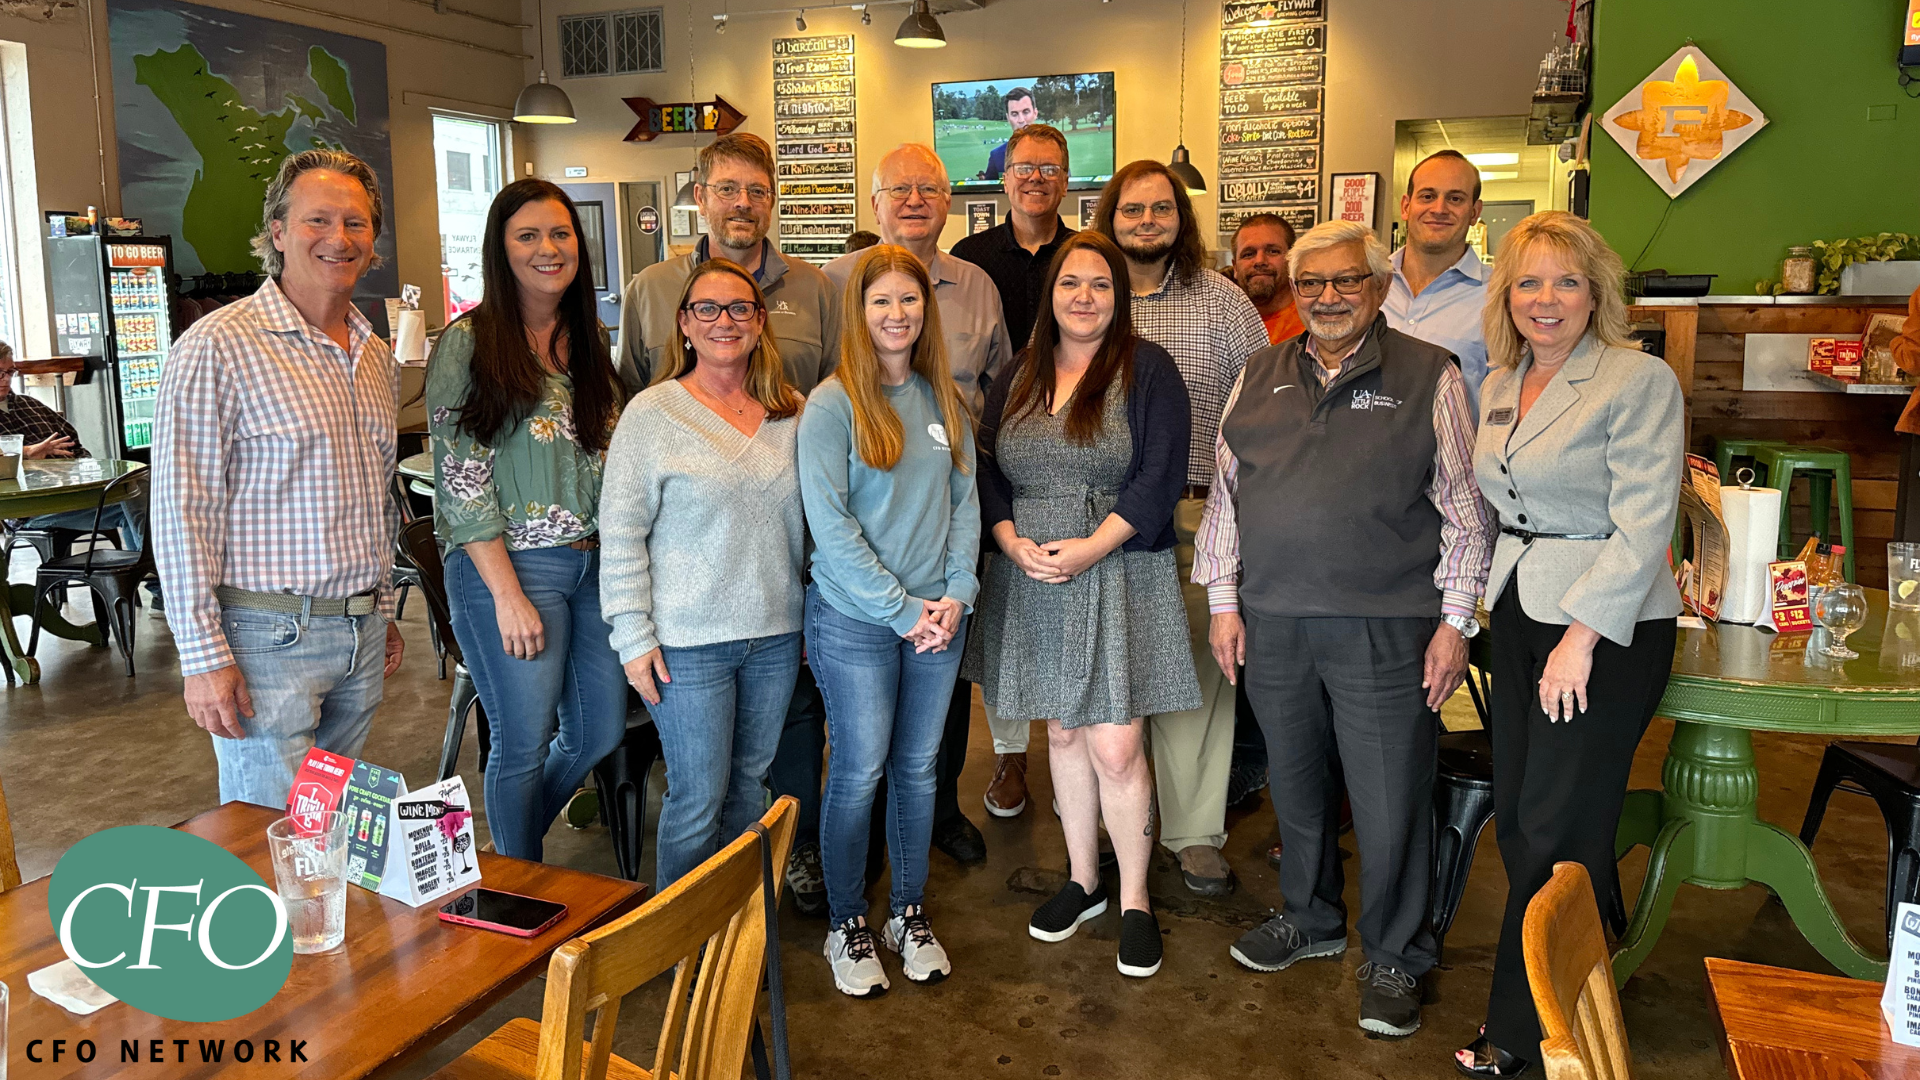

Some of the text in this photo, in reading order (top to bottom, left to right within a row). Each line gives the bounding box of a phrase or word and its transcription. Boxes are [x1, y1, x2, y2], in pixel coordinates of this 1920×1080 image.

[1225, 4, 1261, 23] Welcome
[1228, 28, 1315, 42] WHICH CAME FIRST?
[1224, 94, 1246, 104] BEER
[1270, 102, 1284, 111] days
[1291, 100, 1307, 108] week
[1224, 103, 1249, 114] TO GO
[649, 106, 698, 132] BEER
[1282, 119, 1311, 130] options
[1657, 105, 1708, 137] F
[1222, 132, 1240, 144] Coke
[1241, 131, 1260, 142] Sprite
[786, 144, 804, 154] Lord
[807, 144, 823, 154] God
[1222, 155, 1240, 163] WINE
[1240, 154, 1259, 162] MENU
[790, 184, 811, 195] Golden
[1344, 178, 1366, 188] GOOD
[1224, 182, 1270, 201] LOBLOLLY
[1297, 181, 1315, 198] $4
[1343, 187, 1365, 197] PEOPLE
[1345, 200, 1362, 213] GOOD
[1341, 212, 1364, 222] BEER
[112, 246, 163, 259] TO GO BEER
[1774, 609, 1805, 621] $3 $12
[438, 783, 461, 798] Flyway
[296, 794, 326, 823] TRIVIA
[400, 804, 424, 818] WINE
[408, 824, 434, 839] MOVENDO
[415, 864, 438, 879] IMAGERY
[418, 877, 440, 892] IMAGERY
